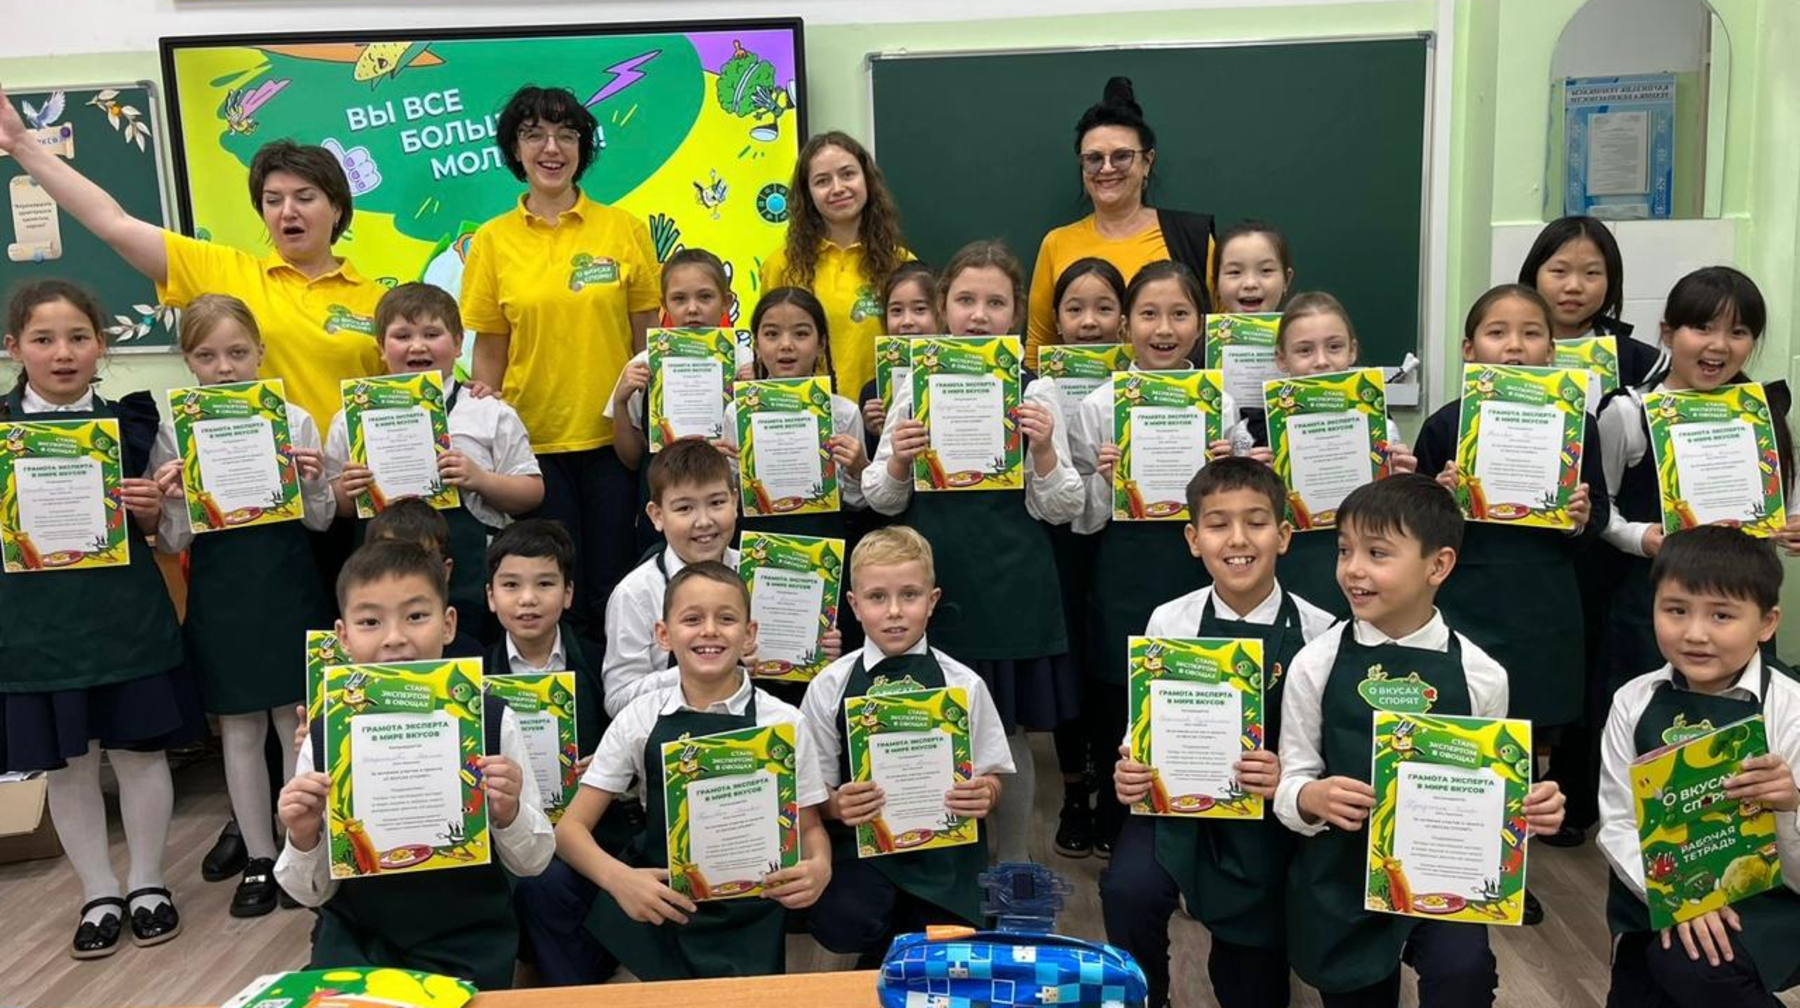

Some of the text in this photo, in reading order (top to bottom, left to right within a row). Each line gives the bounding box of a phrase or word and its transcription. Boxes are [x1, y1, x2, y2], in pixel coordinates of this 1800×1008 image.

[346, 89, 464, 131] ВЫ ВСЕ
[400, 113, 500, 154] БОЛЬ
[1369, 686, 1419, 695] О ВКУСАХ
[1379, 697, 1419, 705] СПОРЯТ
[362, 721, 449, 732] ГРАМОТА ЭКСПЕРТА
[405, 731, 439, 739] ВКУСОВ
[910, 736, 944, 744] ЭКСПЕРТА
[1429, 741, 1477, 757] ЭКСПЕРТОМ
[1451, 739, 1479, 749] СТАНЬ
[1439, 751, 1476, 764] ОВОЩАХ
[697, 778, 769, 794] ГРАМОТА ЭКСПЕРТА
[1408, 774, 1494, 786] ГРАМОТА ЭКСПЕРТА
[711, 792, 731, 800] МИРЕ
[733, 787, 761, 797] ВКУСОВ
[1450, 786, 1485, 794] ВКУСОВ
[1663, 793, 1677, 806] О
[1681, 825, 1735, 854] РАБОЧАЯ
[1683, 838, 1736, 863] ТЕТРАДЬ
